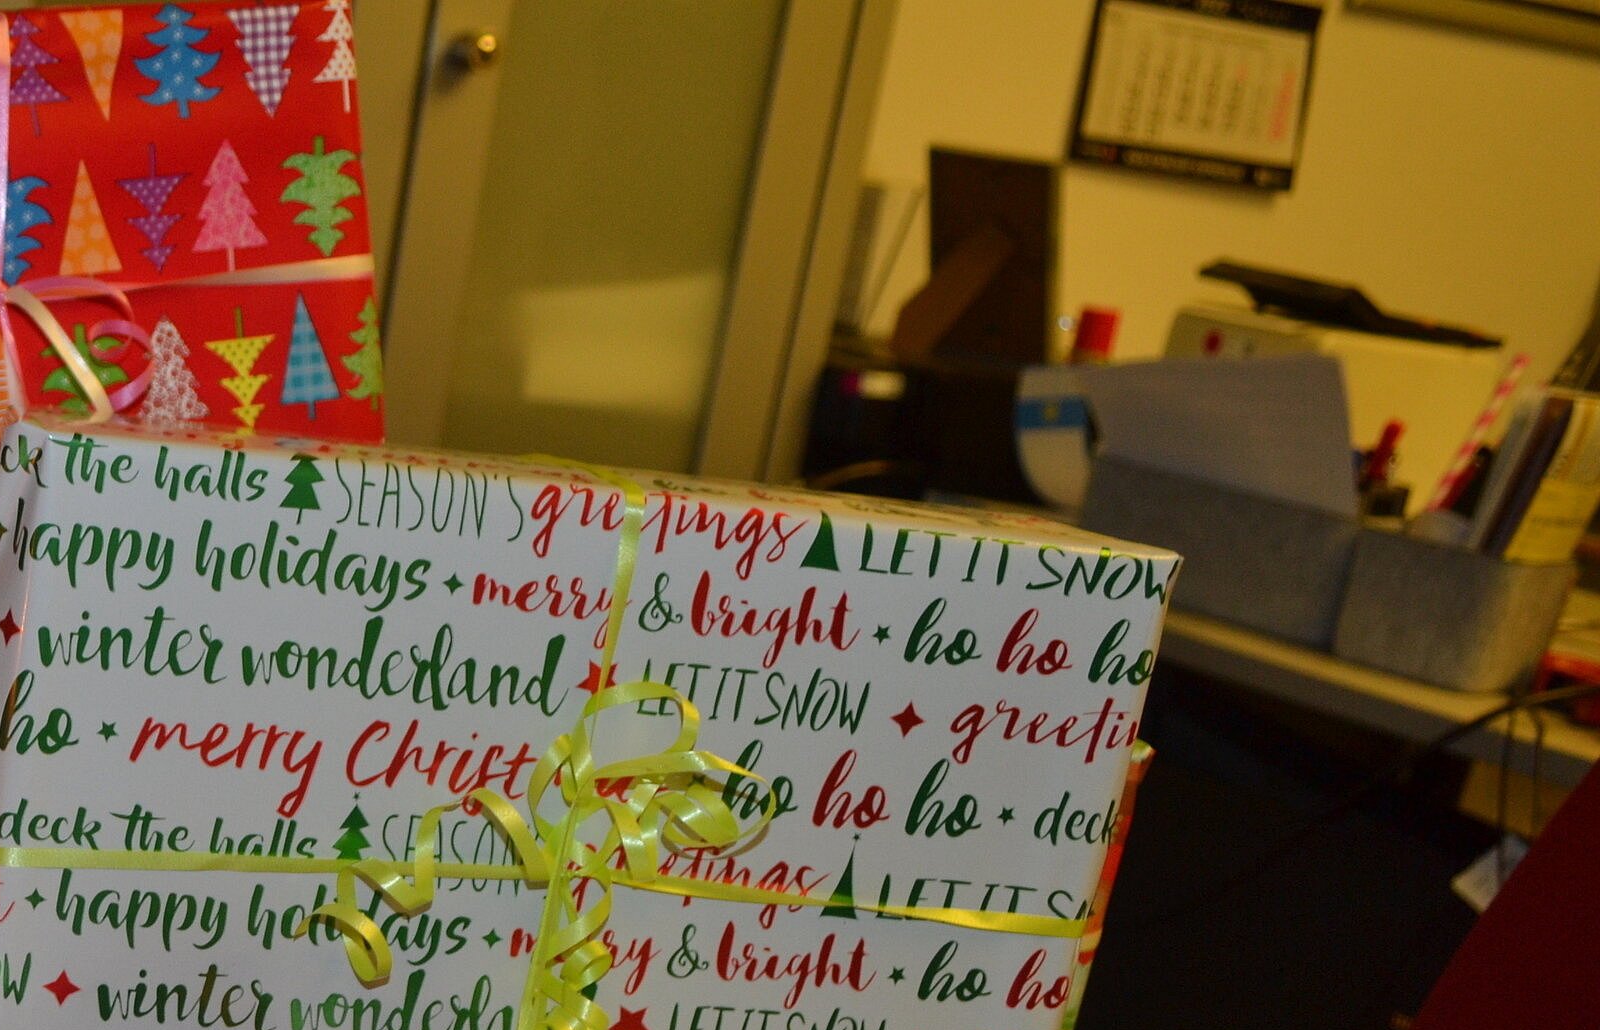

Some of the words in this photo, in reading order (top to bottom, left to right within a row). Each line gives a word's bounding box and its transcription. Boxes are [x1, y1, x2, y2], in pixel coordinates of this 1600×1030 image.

[49, 432, 139, 494] the
[154, 445, 269, 502] halls
[335, 456, 524, 542] SEASON'S
[530, 482, 810, 581] gretings
[859, 522, 958, 579] LET
[961, 536, 1025, 586] IT
[1025, 543, 1181, 605] SNOW
[12, 497, 176, 593] happy
[194, 518, 432, 613] holidays
[638, 571, 684, 633] &
[690, 569, 862, 669] bright
[903, 597, 982, 665] ho
[995, 607, 1073, 675] ho
[1087, 618, 1155, 686] ho
[37, 605, 229, 685] winter
[241, 615, 570, 718] wonderland
[753, 667, 871, 736] SNOW
[109, 803, 196, 853] the
[208, 816, 318, 860] halls
[129, 716, 323, 819] merry
[811, 748, 891, 830] ho
[904, 757, 983, 838] ho
[55, 867, 229, 952] happy
[666, 924, 709, 979] &
[716, 920, 878, 1010] bright
[916, 940, 992, 1002] ho
[1005, 949, 1072, 1011] ho
